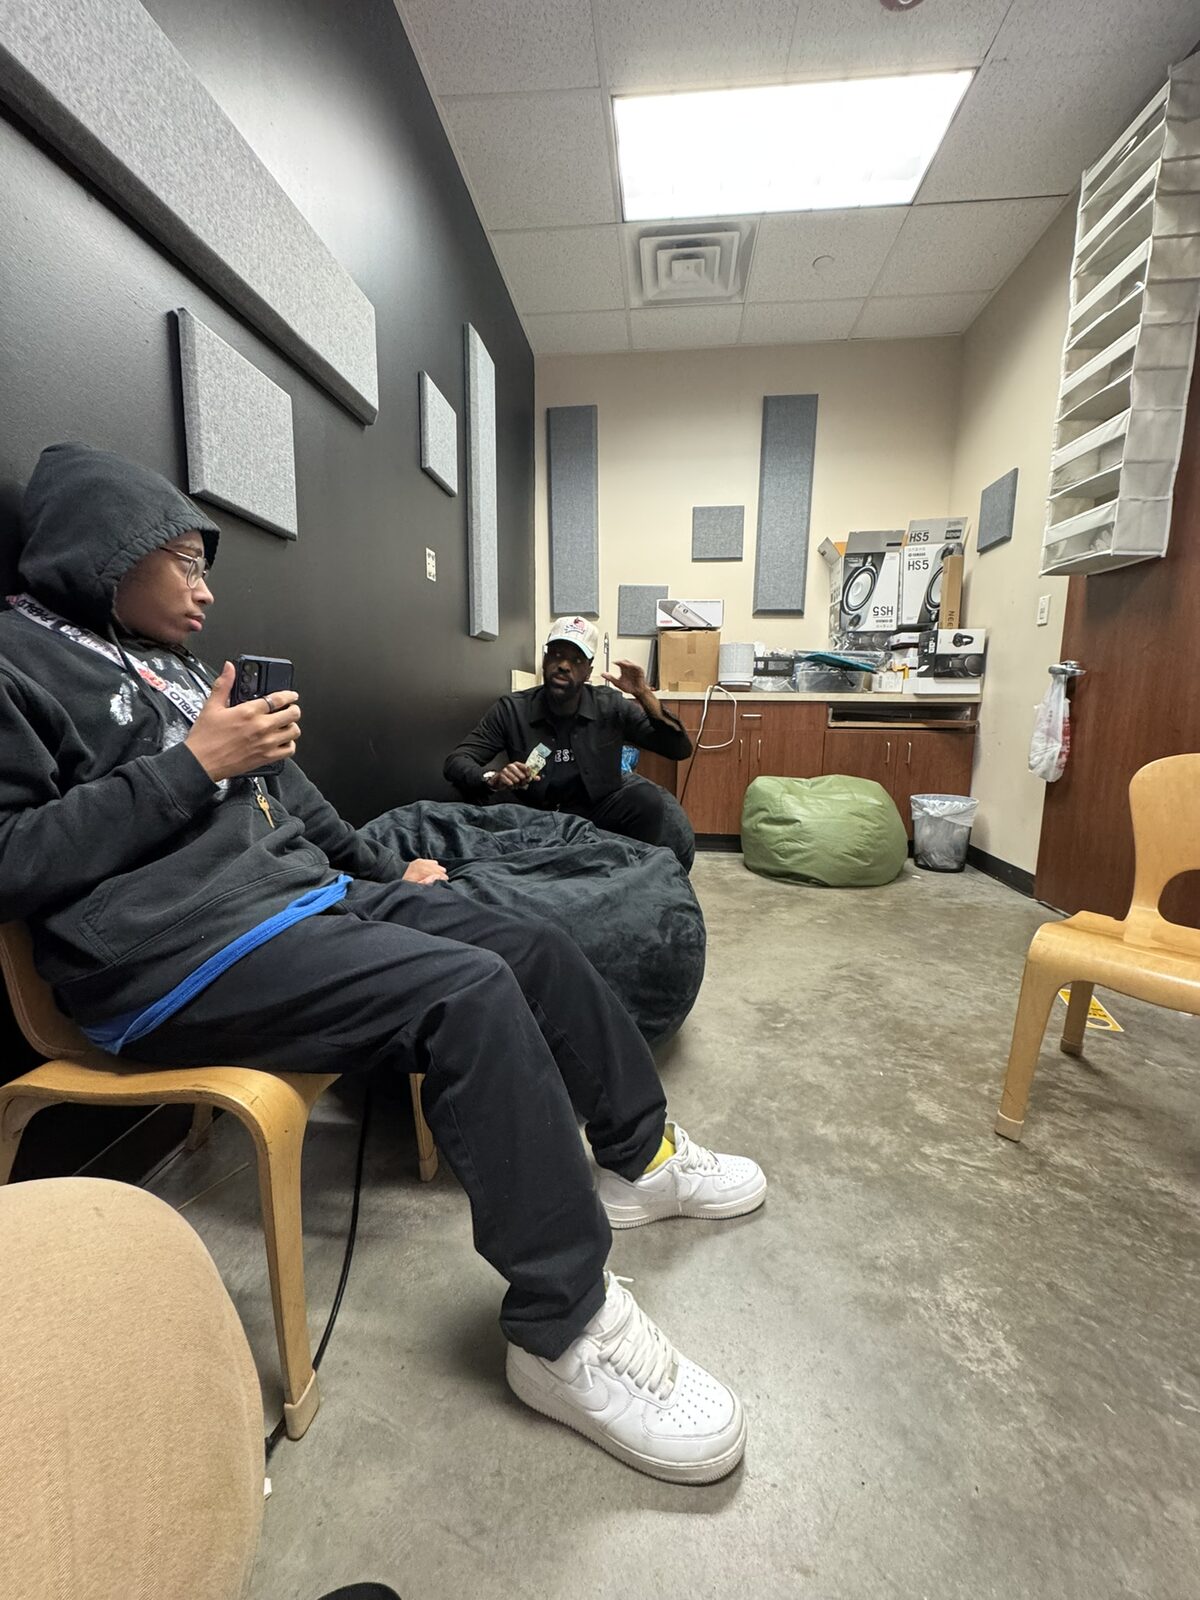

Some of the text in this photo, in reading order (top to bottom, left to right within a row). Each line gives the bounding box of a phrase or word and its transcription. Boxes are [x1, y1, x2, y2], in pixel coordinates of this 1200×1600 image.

[909, 532, 930, 543] HS5
[907, 560, 929, 571] HS5
[872, 606, 894, 617] HS5
